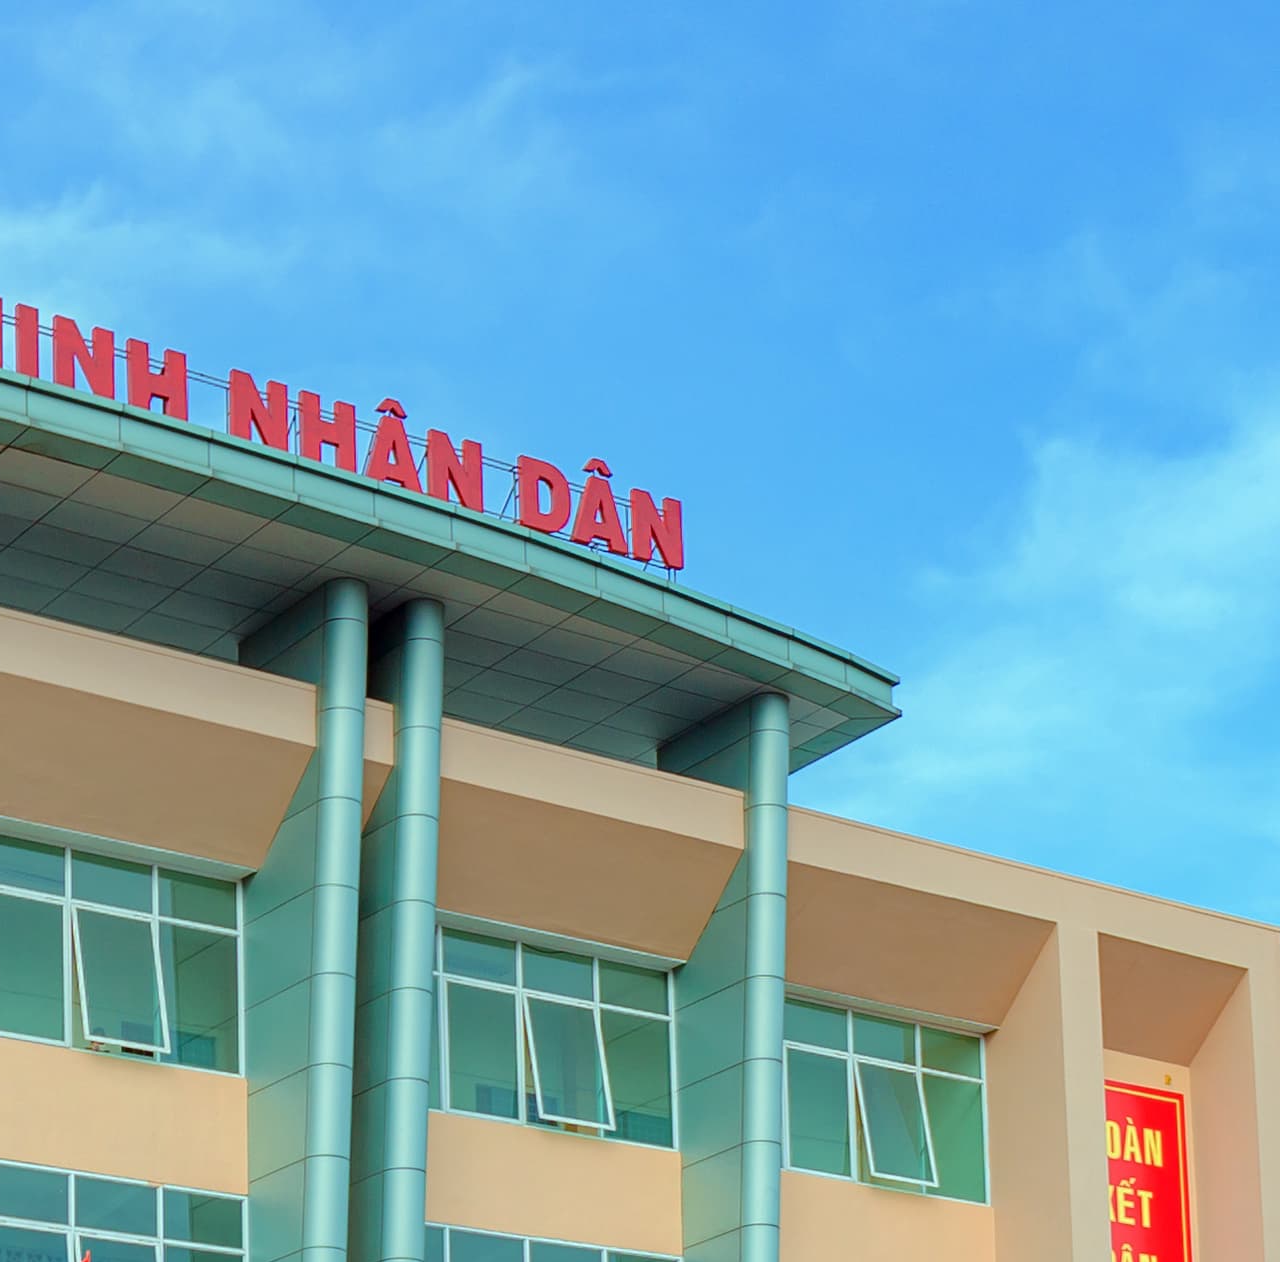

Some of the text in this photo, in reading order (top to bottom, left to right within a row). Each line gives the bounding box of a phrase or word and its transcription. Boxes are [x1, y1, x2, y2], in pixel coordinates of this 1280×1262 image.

[229, 368, 484, 513] NHÂN
[517, 455, 684, 570] DÂN
[1105, 1116, 1163, 1168] OÀN
